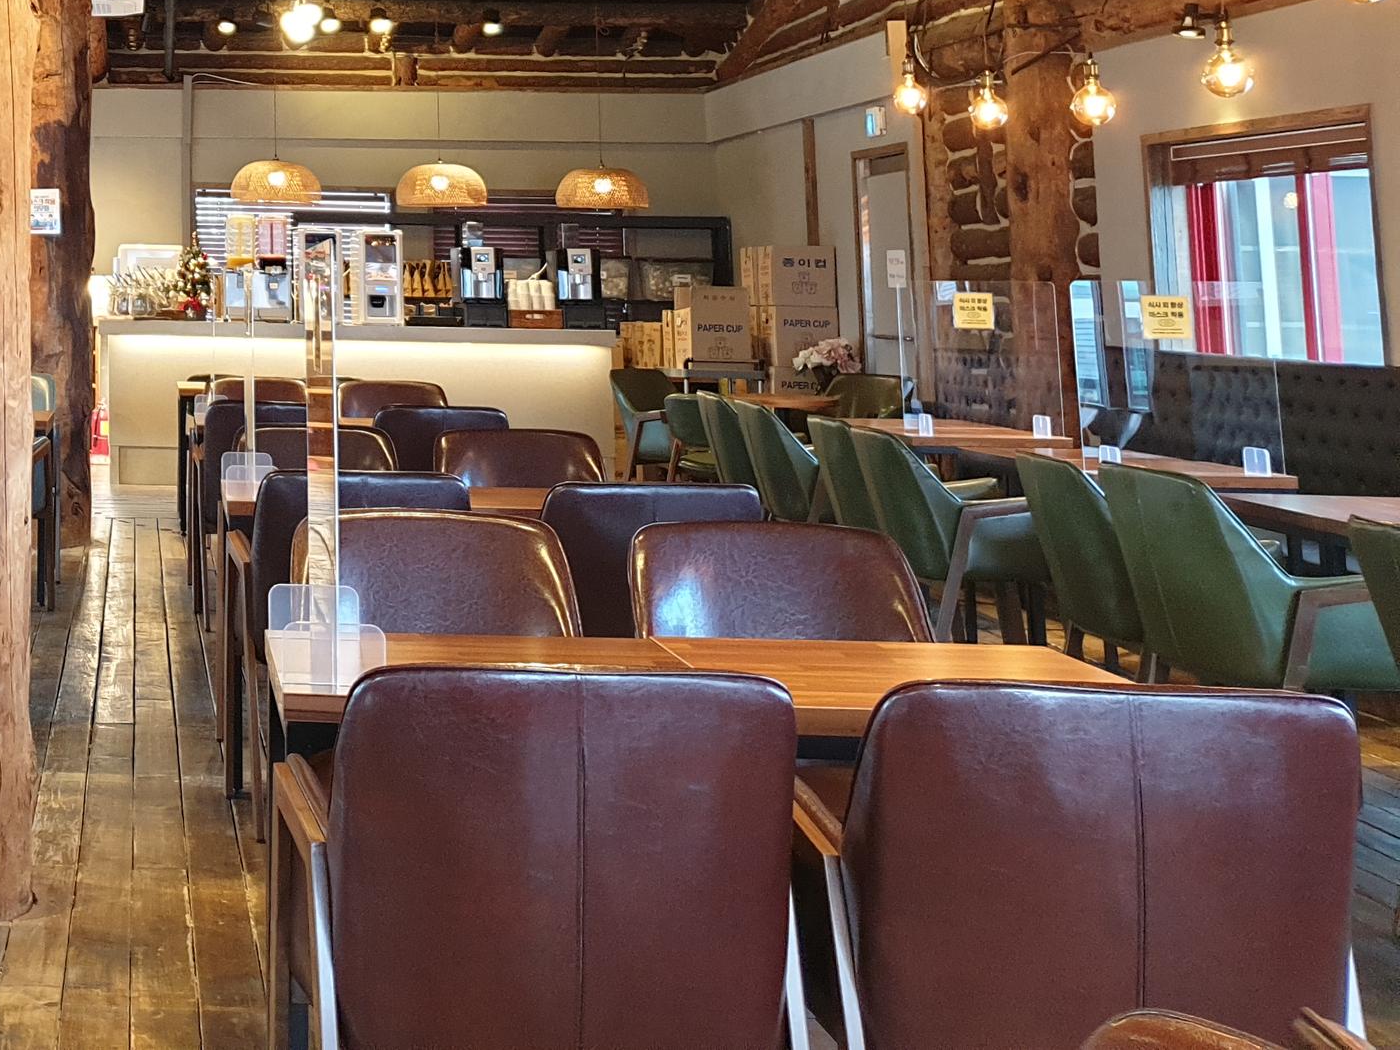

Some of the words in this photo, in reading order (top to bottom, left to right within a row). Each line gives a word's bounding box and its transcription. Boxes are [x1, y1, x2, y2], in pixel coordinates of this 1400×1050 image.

[697, 323, 725, 333] PAPER
[726, 324, 744, 334] CUP
[783, 318, 811, 328] PAPER
[812, 319, 831, 329] CUP
[781, 381, 809, 390] PAPER
